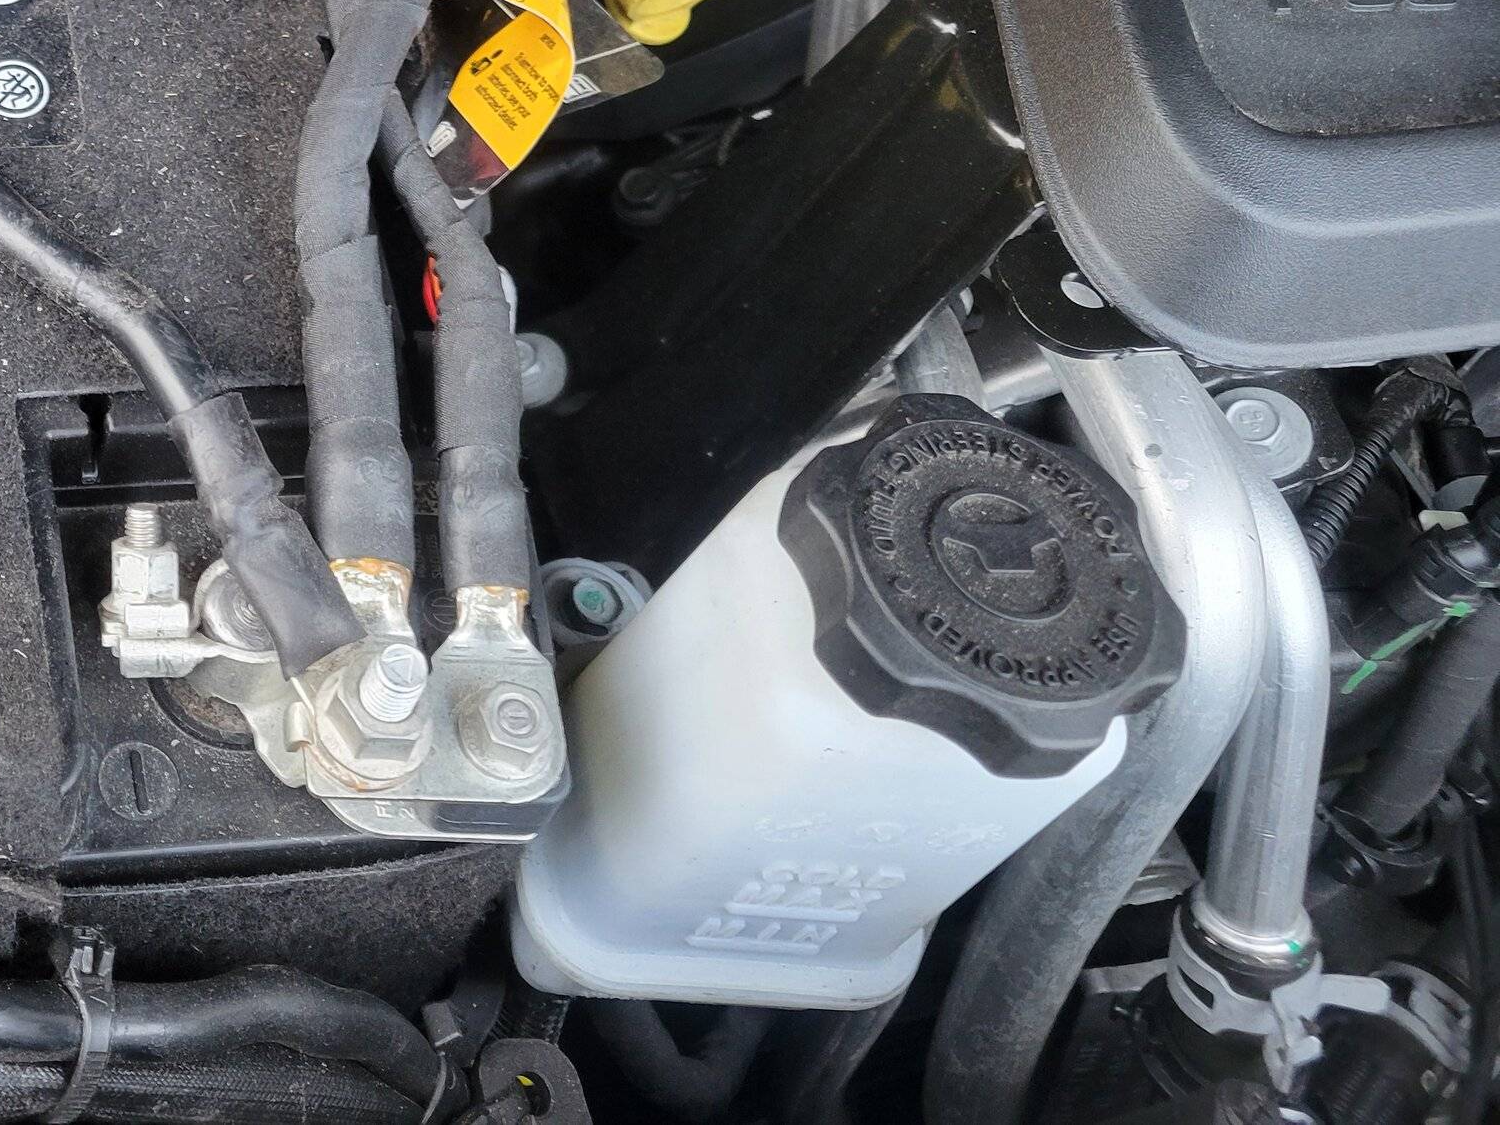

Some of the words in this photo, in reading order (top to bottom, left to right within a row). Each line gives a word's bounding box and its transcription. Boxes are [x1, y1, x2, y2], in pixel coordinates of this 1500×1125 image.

[891, 429, 1029, 476] STEERING
[865, 476, 905, 558] FLUID
[1035, 461, 1134, 561] POWER
[922, 608, 1095, 688] APPROVED
[1096, 611, 1143, 666] USE
